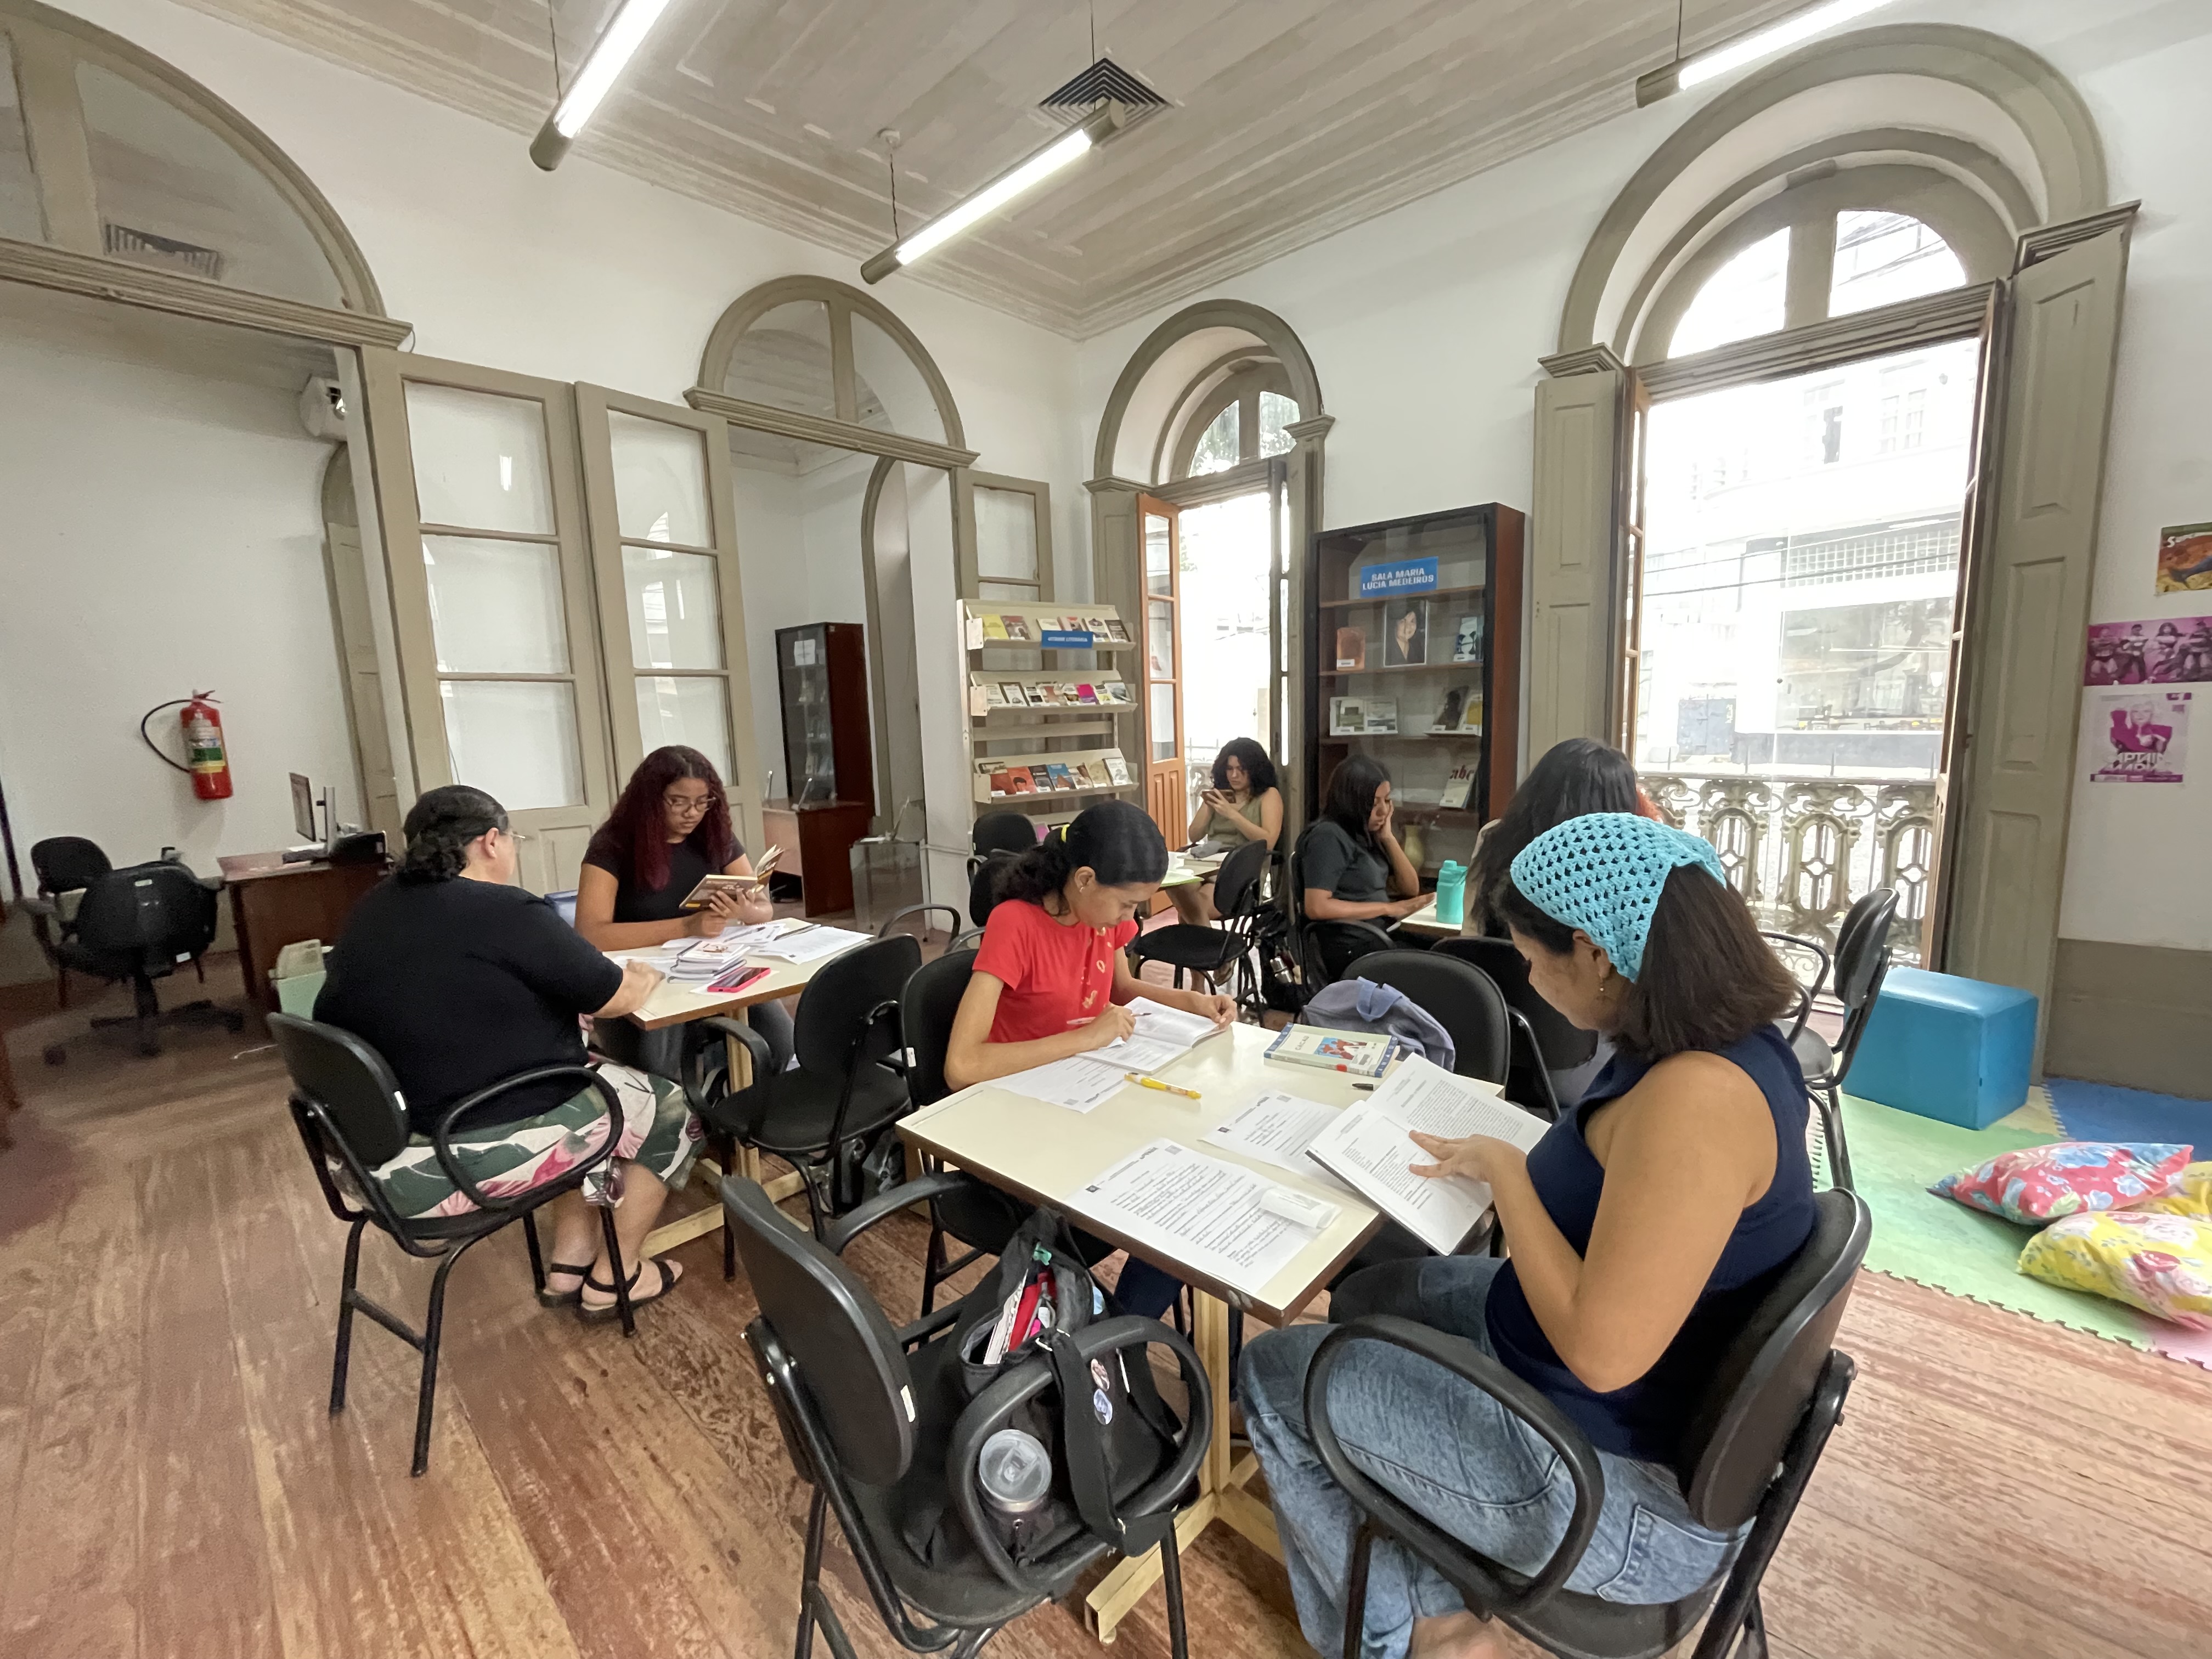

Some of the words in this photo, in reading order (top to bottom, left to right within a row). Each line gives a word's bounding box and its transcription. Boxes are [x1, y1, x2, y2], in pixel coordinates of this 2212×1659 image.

[1372, 572, 1392, 582] SALA
[1395, 568, 1425, 578] MARIA
[1389, 574, 1434, 587] MEDEIROS
